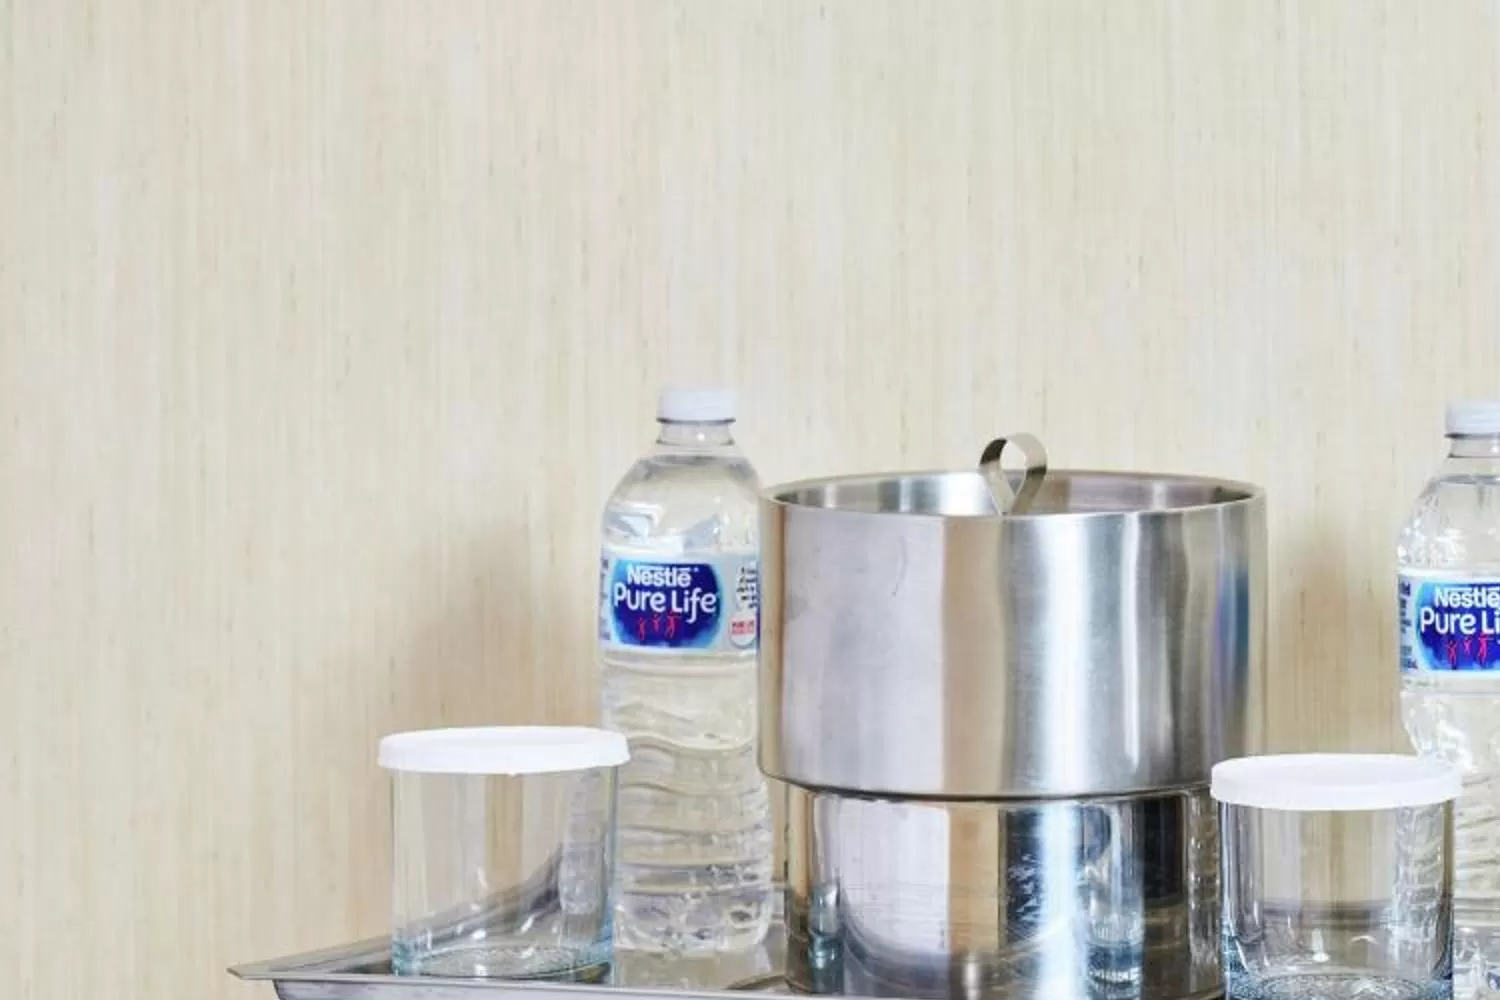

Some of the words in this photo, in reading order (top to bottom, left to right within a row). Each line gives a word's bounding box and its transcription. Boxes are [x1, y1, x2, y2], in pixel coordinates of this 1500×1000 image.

[613, 581, 667, 613] Pure
[671, 587, 717, 623] Life
[1420, 606, 1476, 635] Pure
